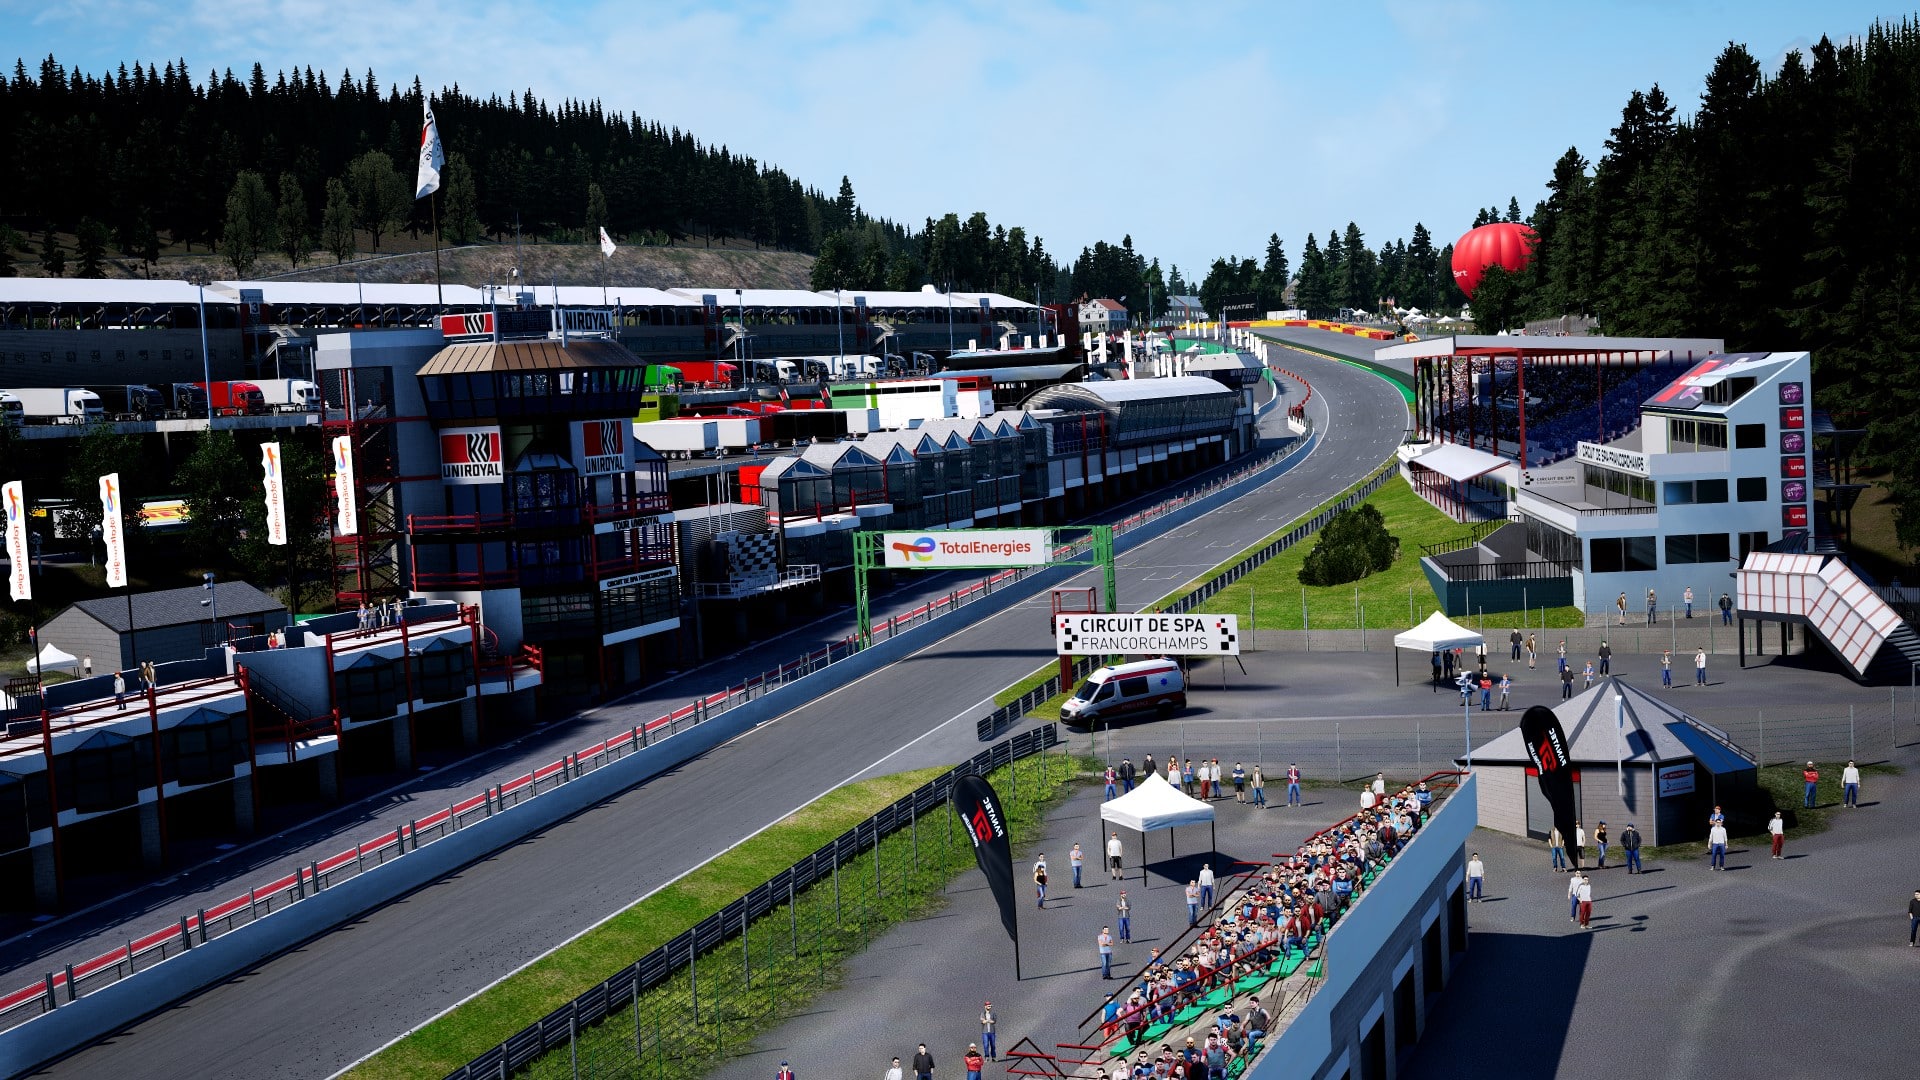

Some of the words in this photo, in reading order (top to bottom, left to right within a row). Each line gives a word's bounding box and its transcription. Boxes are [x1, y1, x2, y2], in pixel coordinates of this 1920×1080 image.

[251, 303, 259, 313] 3
[710, 304, 715, 314] 5
[1222, 303, 1256, 311] FANATEC
[442, 463, 502, 478] UNIROYAL
[584, 455, 625, 476] UNIROYAL
[613, 520, 630, 531] TOUR
[939, 540, 1031, 556] TotalEnergies
[1080, 618, 1143, 633] CIRCUIT
[1149, 618, 1169, 633] DE
[1174, 618, 1206, 633] SPA
[1081, 637, 1208, 651] FRANCORCHAMPS
